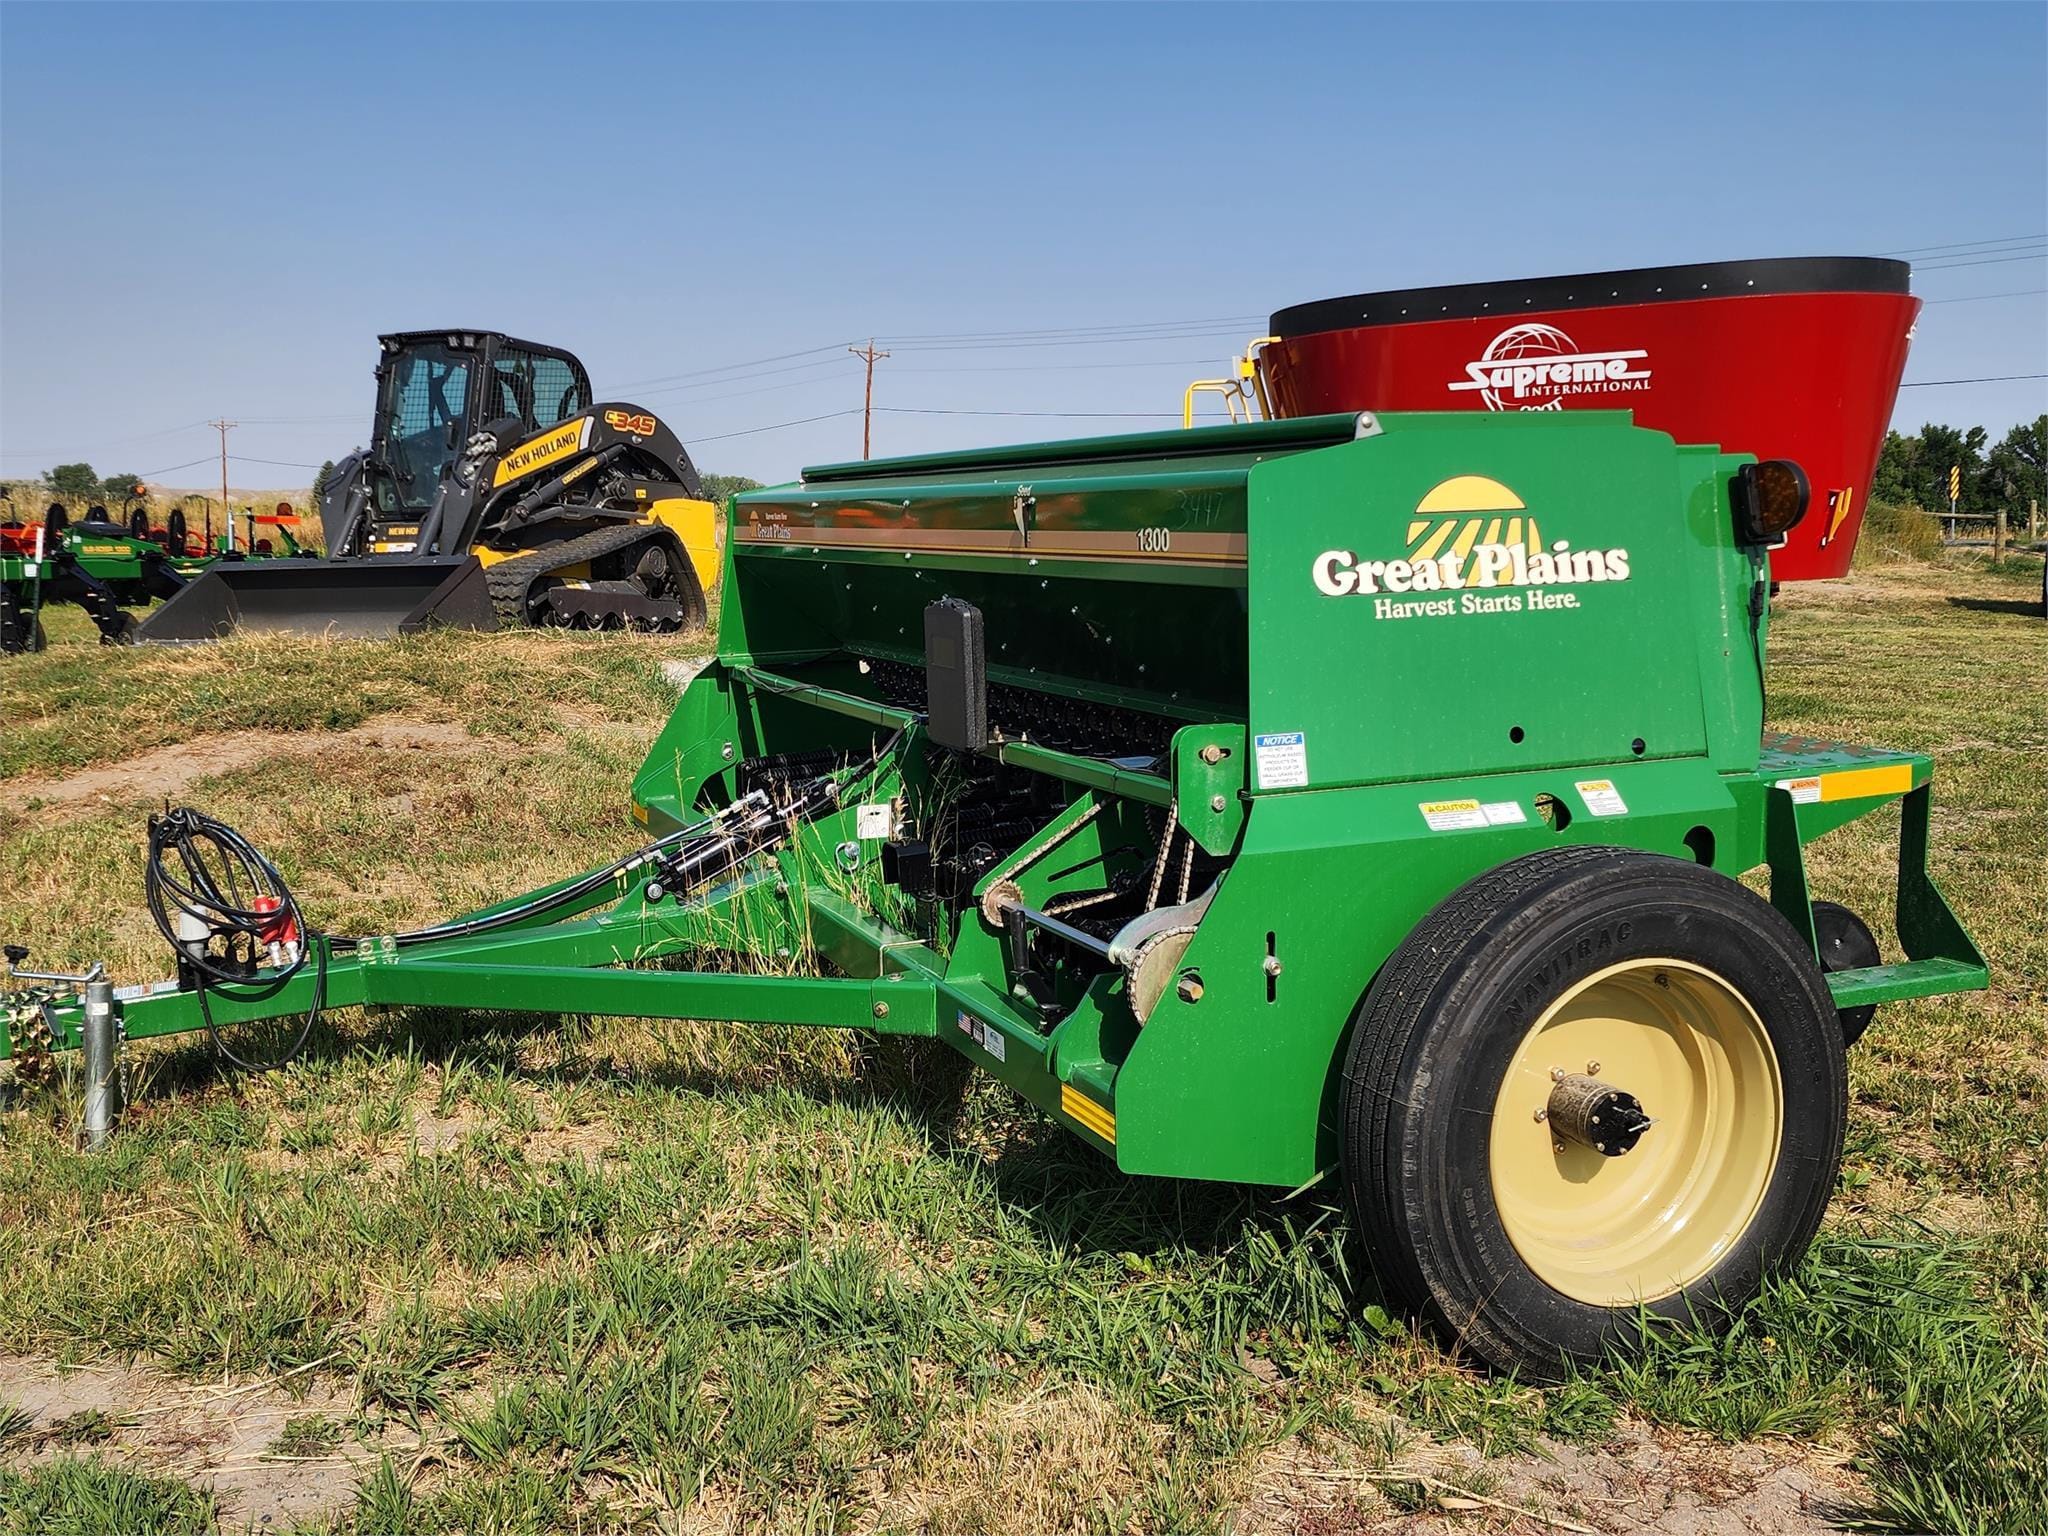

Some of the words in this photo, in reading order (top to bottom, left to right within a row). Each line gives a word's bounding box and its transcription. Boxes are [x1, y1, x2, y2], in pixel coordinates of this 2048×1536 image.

[1448, 350, 1651, 398] Supreme
[1525, 380, 1651, 398] INTERNATIONAL
[507, 453, 531, 472] NEW
[532, 432, 577, 461] HOLLAND
[388, 527, 405, 536] NEW
[757, 523, 773, 538] Great
[773, 523, 791, 539] Plains
[1136, 527, 1170, 552] 1300
[1312, 548, 1467, 597] Great
[1473, 541, 1631, 587] Plains
[1373, 596, 1456, 619] Harvest
[1461, 593, 1522, 614] Starts
[1527, 590, 1580, 610] Here.
[1263, 735, 1298, 746] NOTICE
[1435, 803, 1475, 812] CAUTION
[1503, 920, 1633, 1028] NAVITRAC
